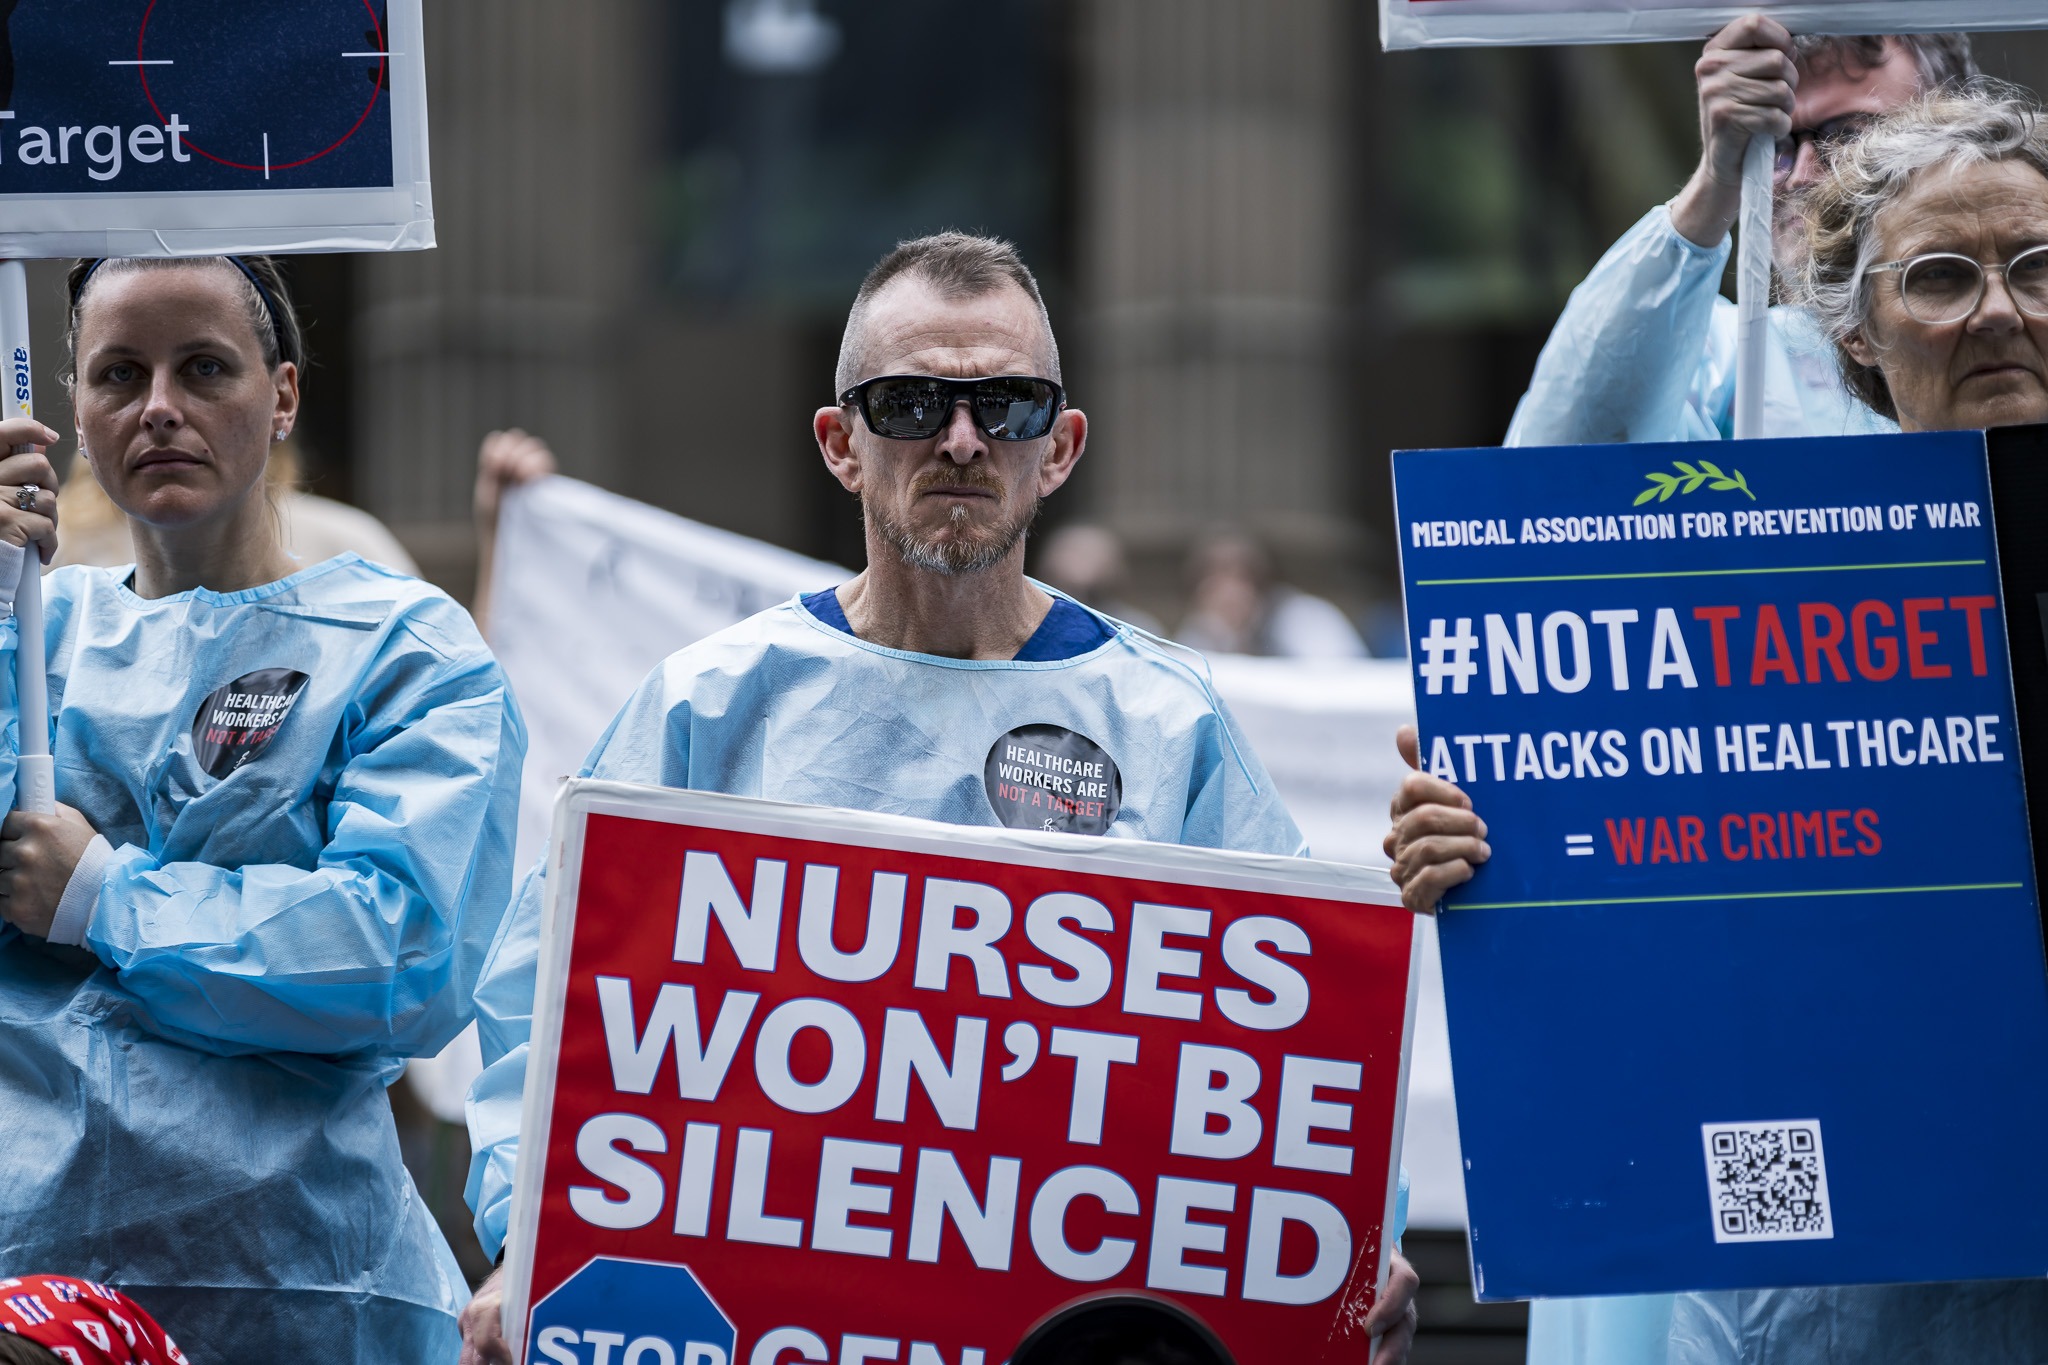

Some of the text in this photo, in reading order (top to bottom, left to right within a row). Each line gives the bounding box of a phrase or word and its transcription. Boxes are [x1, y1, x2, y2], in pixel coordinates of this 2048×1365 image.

[1411, 502, 1981, 548] MEDICAL ASSOCIATION FOR PREVENTION OF WAR
[212, 708, 280, 728] WORKERS
[224, 692, 296, 711] HEALTHCA
[206, 727, 237, 745] NOT
[237, 731, 248, 746] A
[1428, 715, 2004, 783] ATTACKS ON HEALTHCARE
[998, 762, 1108, 799] WORKERS ARE
[1006, 744, 1104, 779] HEALTHCARE
[998, 782, 1105, 818] NOT A TARGET
[1605, 816, 1708, 865] WAR
[1720, 809, 1882, 861] CRIMES
[672, 850, 1312, 1031] NURSES
[1169, 1042, 1364, 1175] BE
[568, 1112, 1354, 1306] SILENCED
